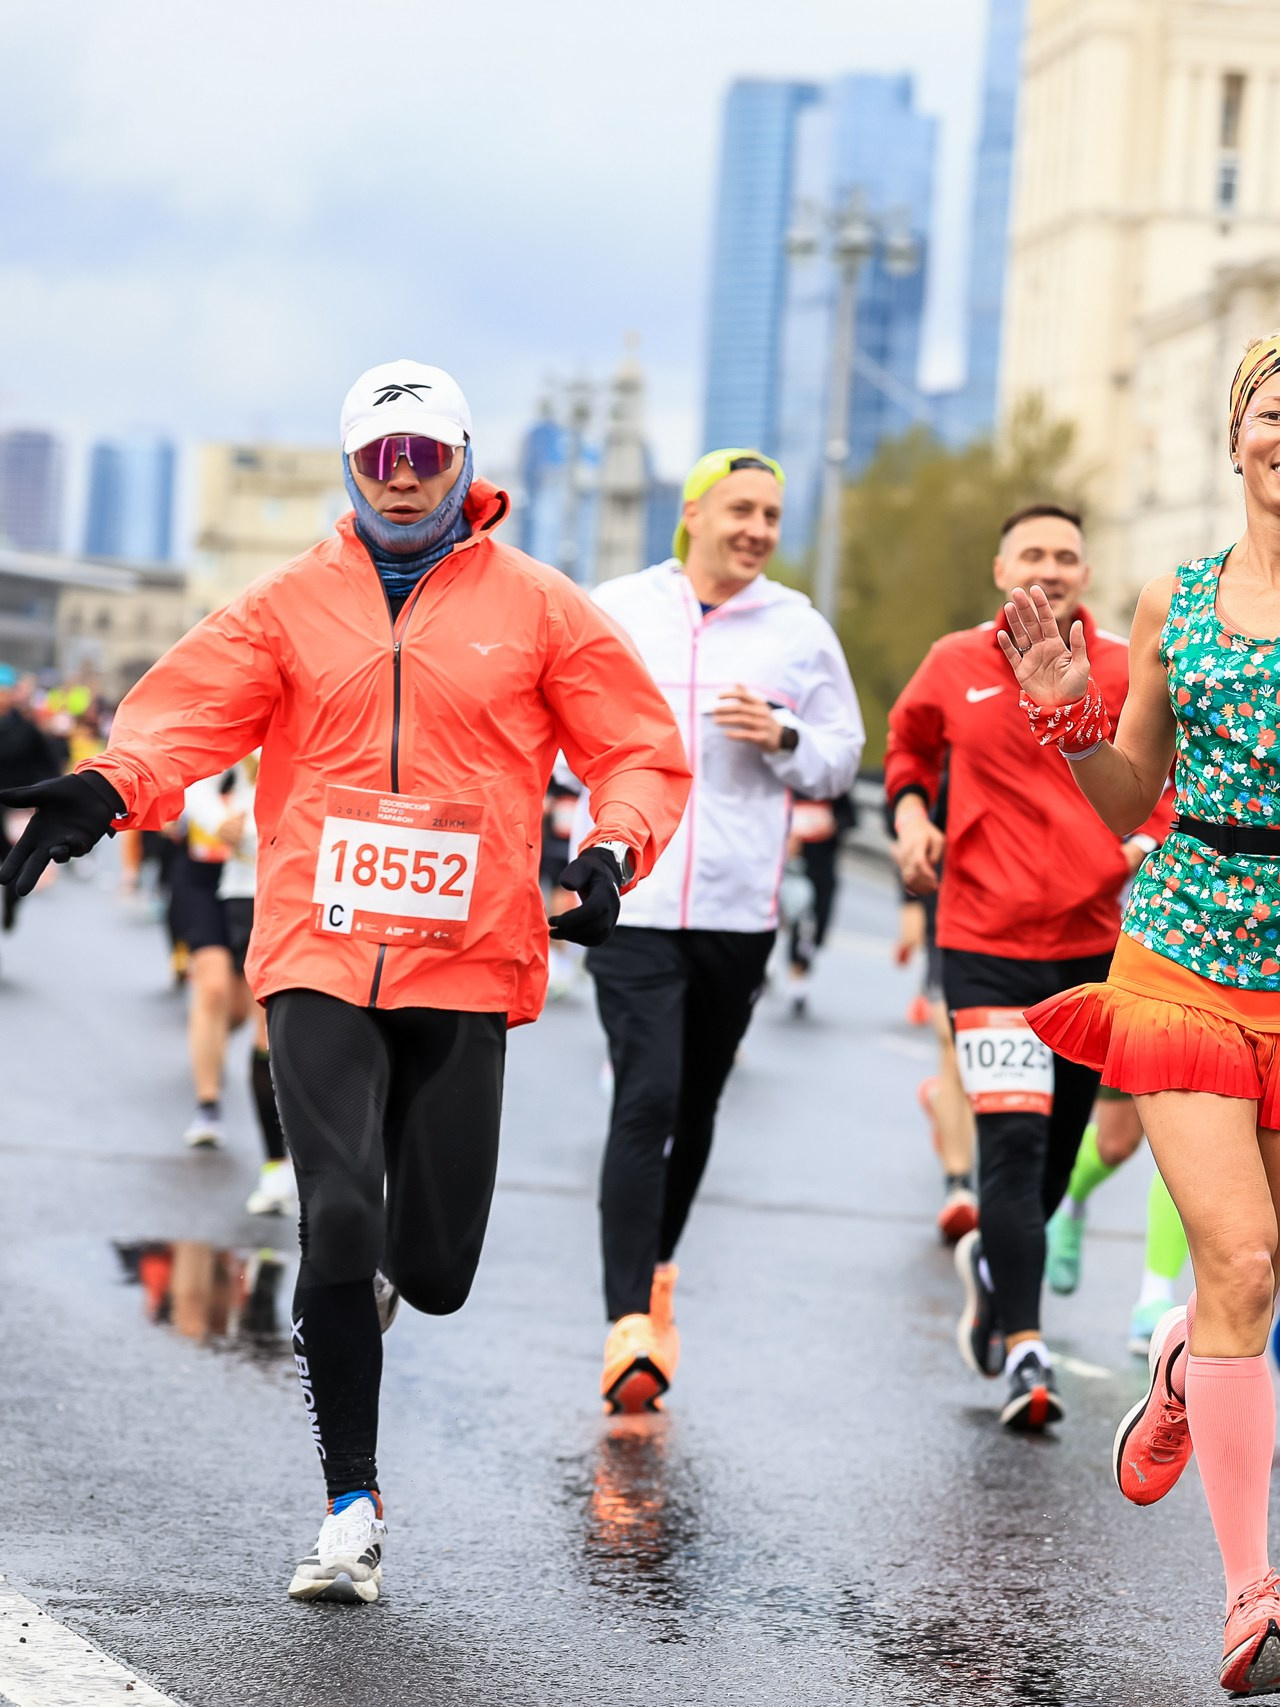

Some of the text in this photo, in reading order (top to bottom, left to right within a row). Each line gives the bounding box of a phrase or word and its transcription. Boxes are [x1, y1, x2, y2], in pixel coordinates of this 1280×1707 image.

[377, 813, 414, 824] МАРАФОН
[330, 839, 468, 897] 18552
[328, 904, 345, 927] C
